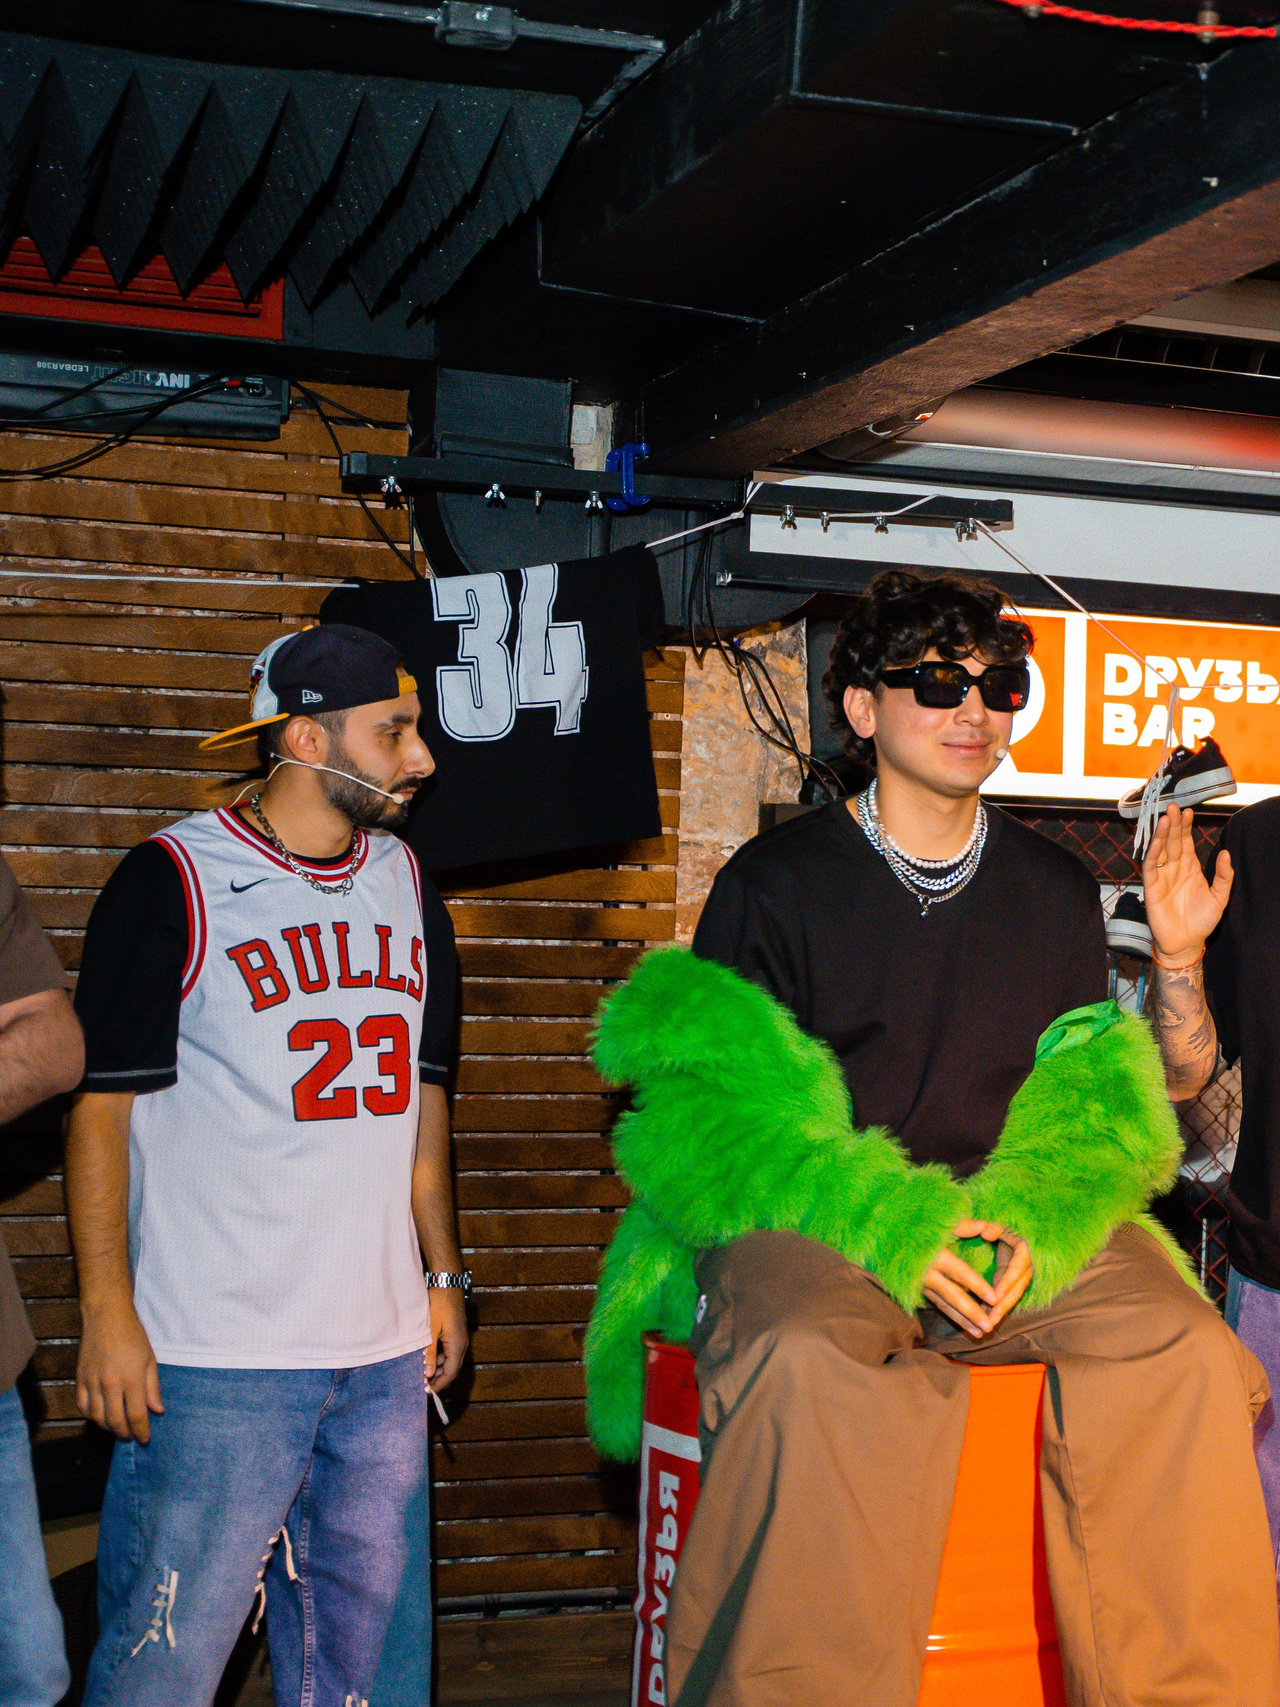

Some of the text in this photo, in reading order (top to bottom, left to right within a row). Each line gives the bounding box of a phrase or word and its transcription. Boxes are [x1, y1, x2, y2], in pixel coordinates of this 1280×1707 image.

[36, 360, 90, 374] LEDBAR308
[430, 563, 589, 742] 34
[1102, 702, 1216, 749] BAR
[225, 921, 424, 1013] BULLS
[287, 1013, 412, 1122] 23
